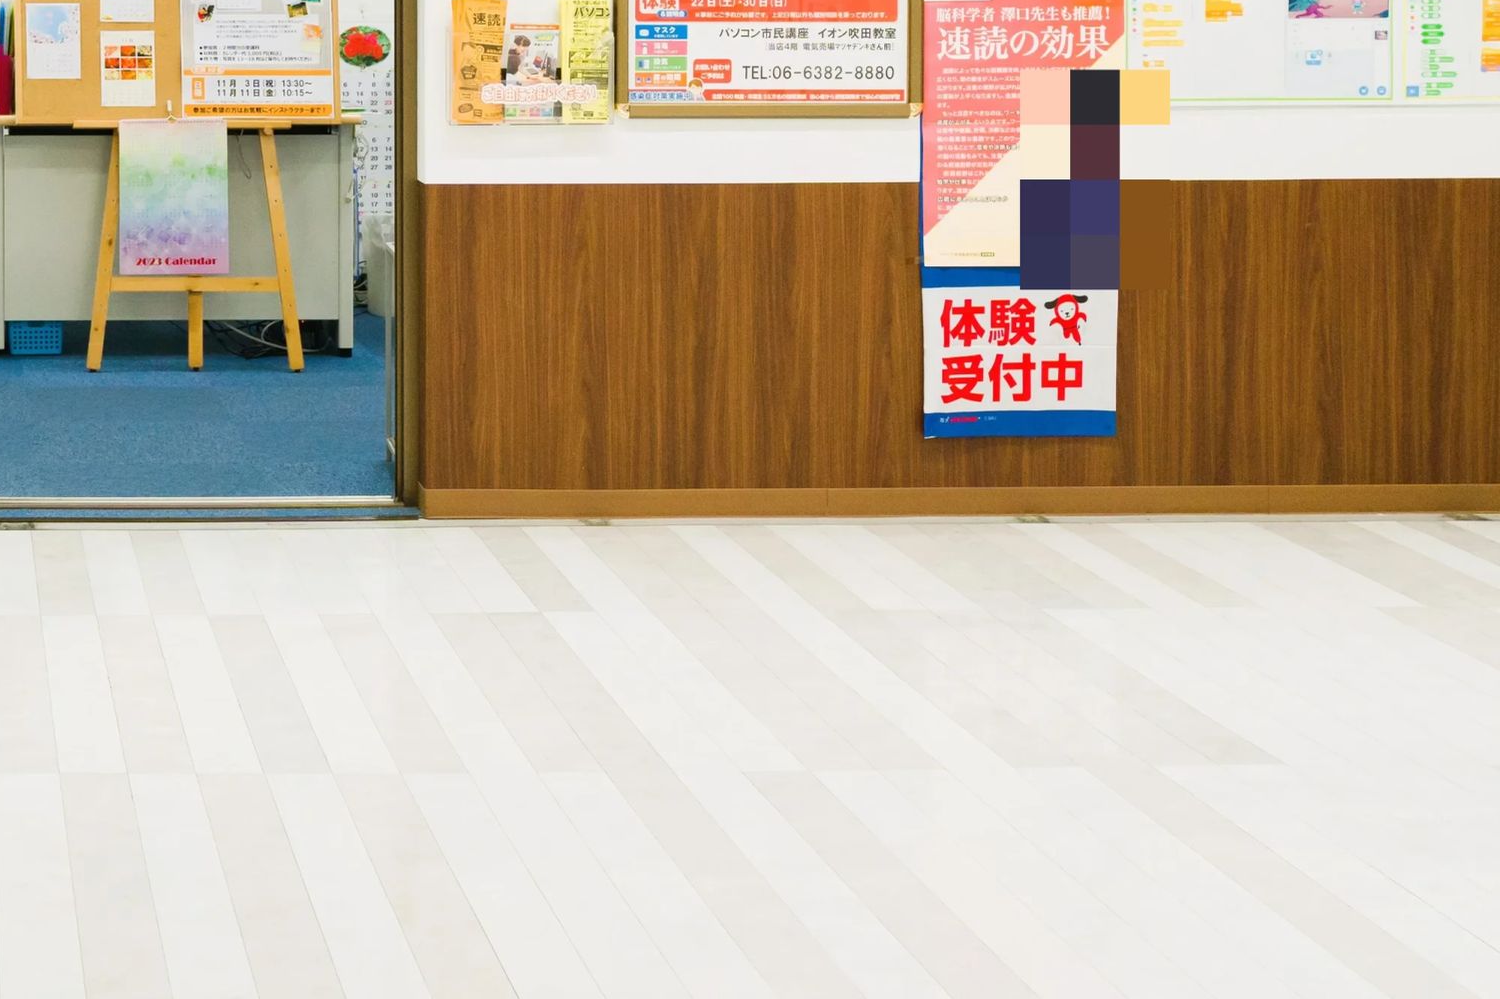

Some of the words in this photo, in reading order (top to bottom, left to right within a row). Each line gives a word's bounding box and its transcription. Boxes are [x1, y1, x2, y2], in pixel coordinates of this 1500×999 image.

[937, 7, 995, 23] 脳科学者
[653, 26, 676, 34] マスク
[719, 27, 809, 40] パソコン市民講座
[818, 27, 897, 40] イオン吹田教室
[937, 25, 1111, 61] 速読の効果
[742, 65, 895, 81] TEL:06-6382-8880
[136, 257, 162, 266] 2023
[165, 256, 217, 266] Calendar
[940, 298, 1036, 348] 体験
[940, 352, 1083, 404] 受付中
